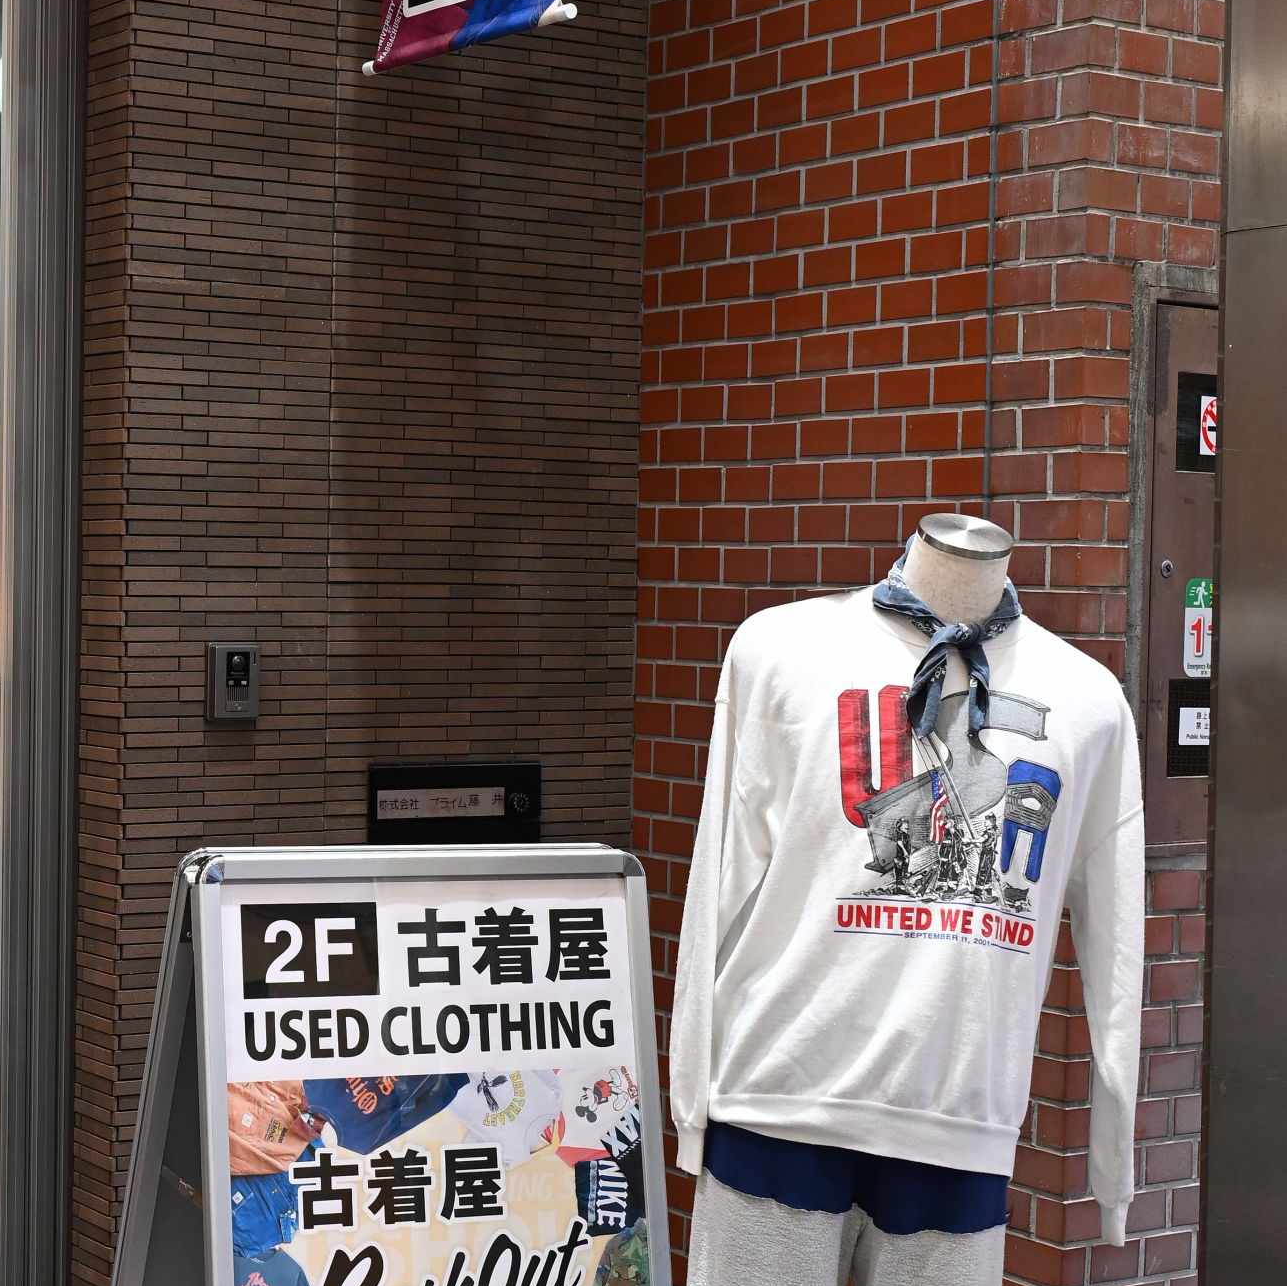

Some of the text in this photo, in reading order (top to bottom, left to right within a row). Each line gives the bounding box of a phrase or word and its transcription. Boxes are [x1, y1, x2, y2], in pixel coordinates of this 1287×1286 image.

[264, 907, 612, 988] 2F 古着屋
[837, 904, 933, 931] UNITED
[940, 908, 974, 934] WE
[904, 931, 959, 941] SEPTEMBER
[973, 937, 990, 946] 2001
[244, 999, 616, 1061] USED CLOTHING
[482, 1070, 526, 1127] NORTHEAST
[293, 1147, 504, 1230] 古着屋
[596, 1160, 629, 1229] NIKE
